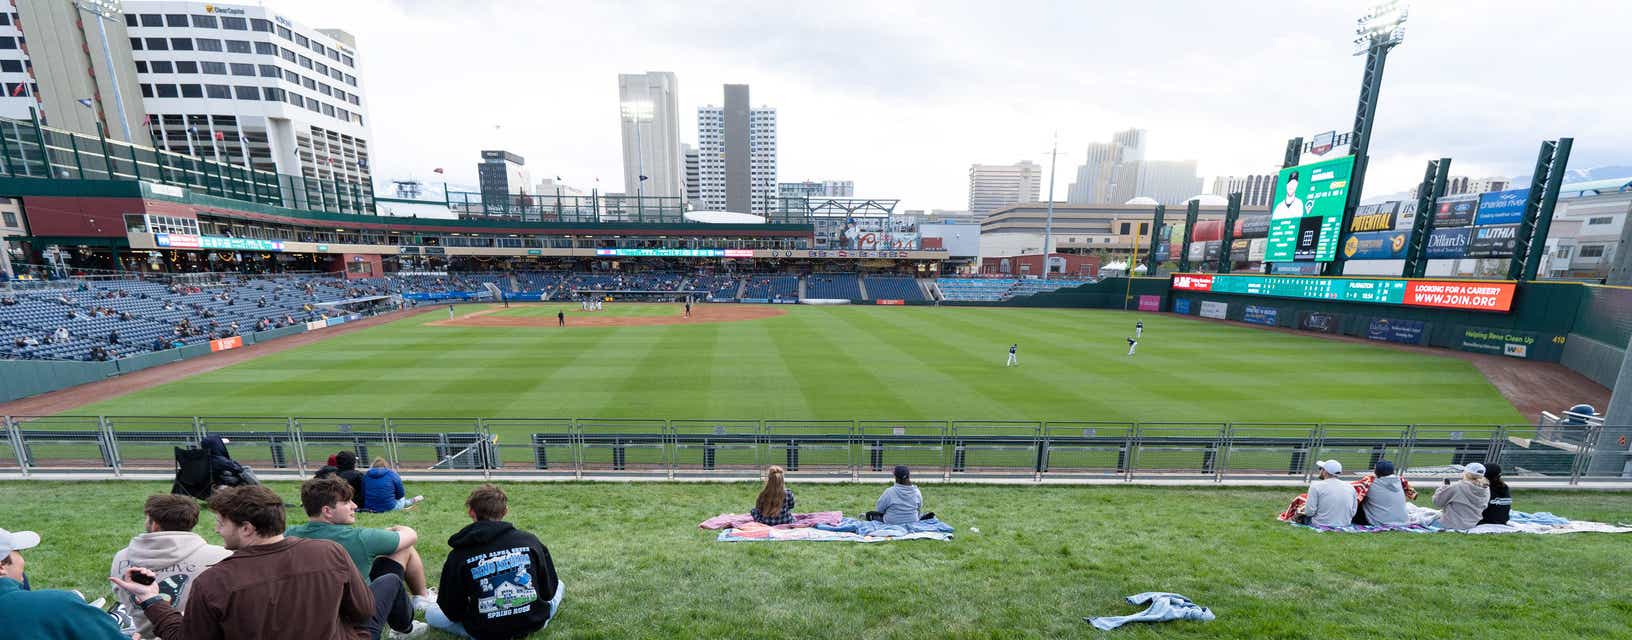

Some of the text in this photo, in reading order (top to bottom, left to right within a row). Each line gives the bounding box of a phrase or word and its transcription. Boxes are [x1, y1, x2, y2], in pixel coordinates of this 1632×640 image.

[1508, 199, 1527, 207] river
[1350, 213, 1391, 232] POTENTIAL
[1486, 227, 1515, 239] LITHIA
[1427, 233, 1466, 248] Dillard's
[1415, 285, 1444, 293] LOOKING
[1466, 287, 1501, 296] CAREER?
[1415, 293, 1497, 306] WWW.JOIN.ORG
[1505, 334, 1523, 343] Clean
[1524, 336, 1535, 345] Up
[1552, 335, 1566, 344] 410
[488, 608, 513, 619] SPRING
